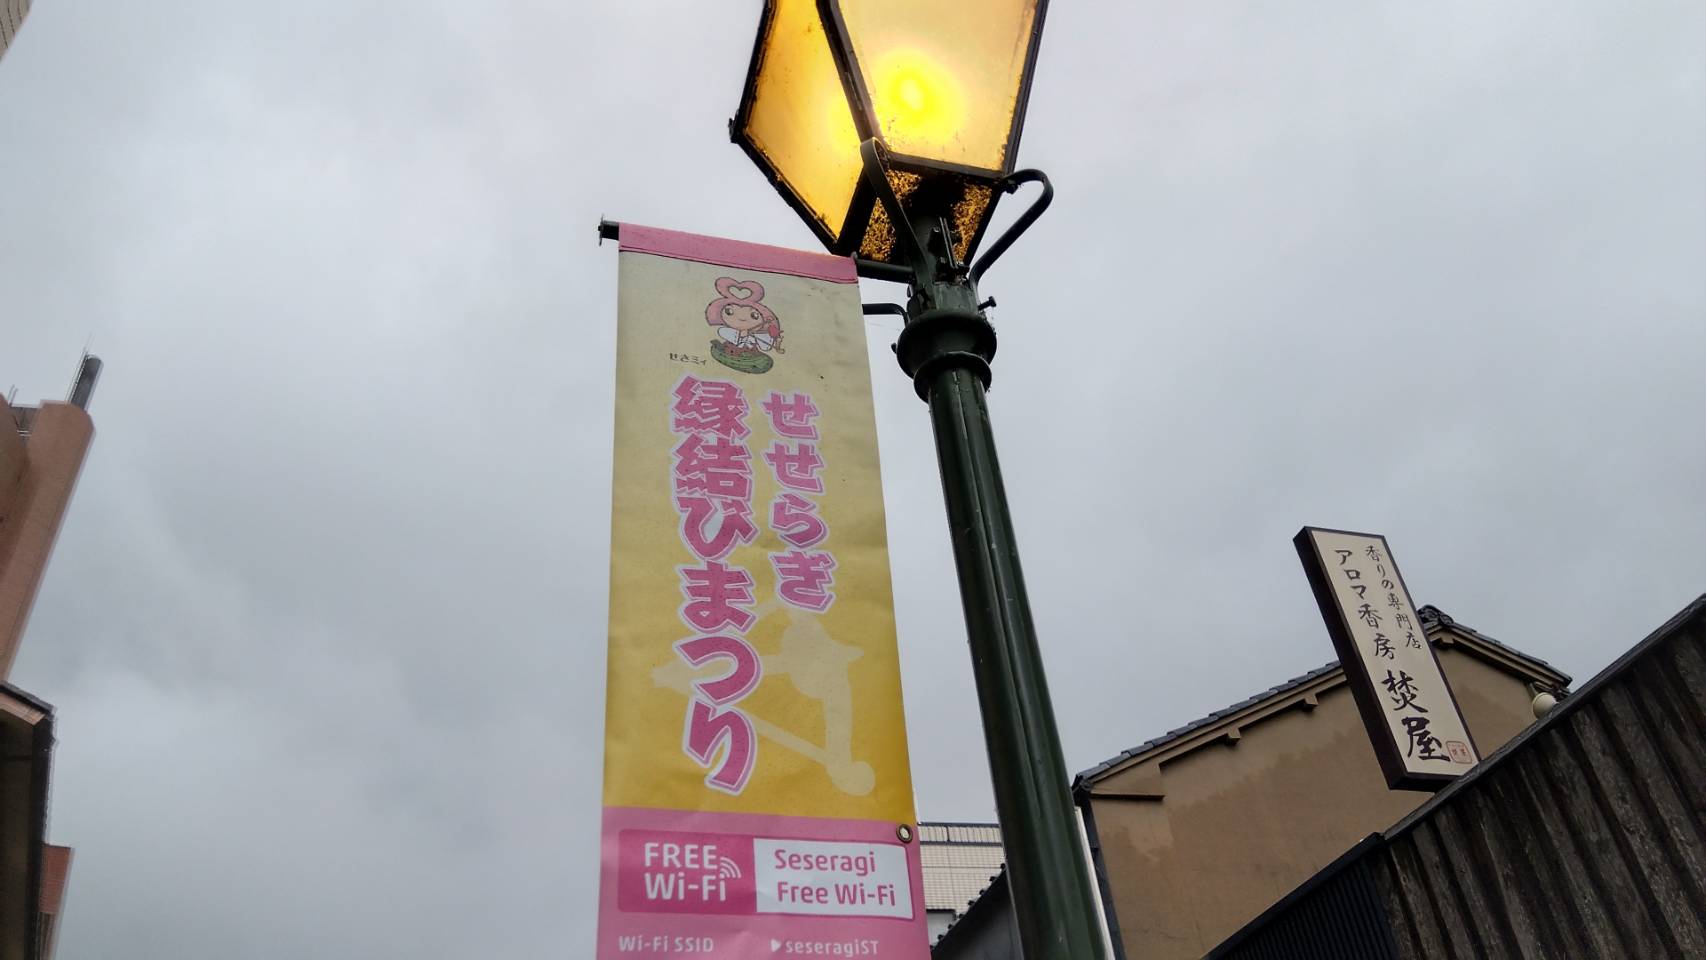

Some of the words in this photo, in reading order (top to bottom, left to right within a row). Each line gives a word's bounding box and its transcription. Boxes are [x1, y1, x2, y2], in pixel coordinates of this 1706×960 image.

[763, 391, 838, 614] せせらぎ
[670, 374, 760, 797] 縁結びまつり
[1336, 549, 1395, 660] アロマ香房
[1382, 669, 1451, 762] 焚屋
[644, 842, 719, 869] FREE
[774, 849, 876, 876] Seseragi
[644, 872, 727, 901] Wi-Fi
[777, 881, 829, 905] Free
[836, 883, 895, 907] Wi-Fi
[618, 935, 670, 952] Wi-Fi
[674, 936, 714, 952] SSID
[785, 939, 879, 957] seseragiST
